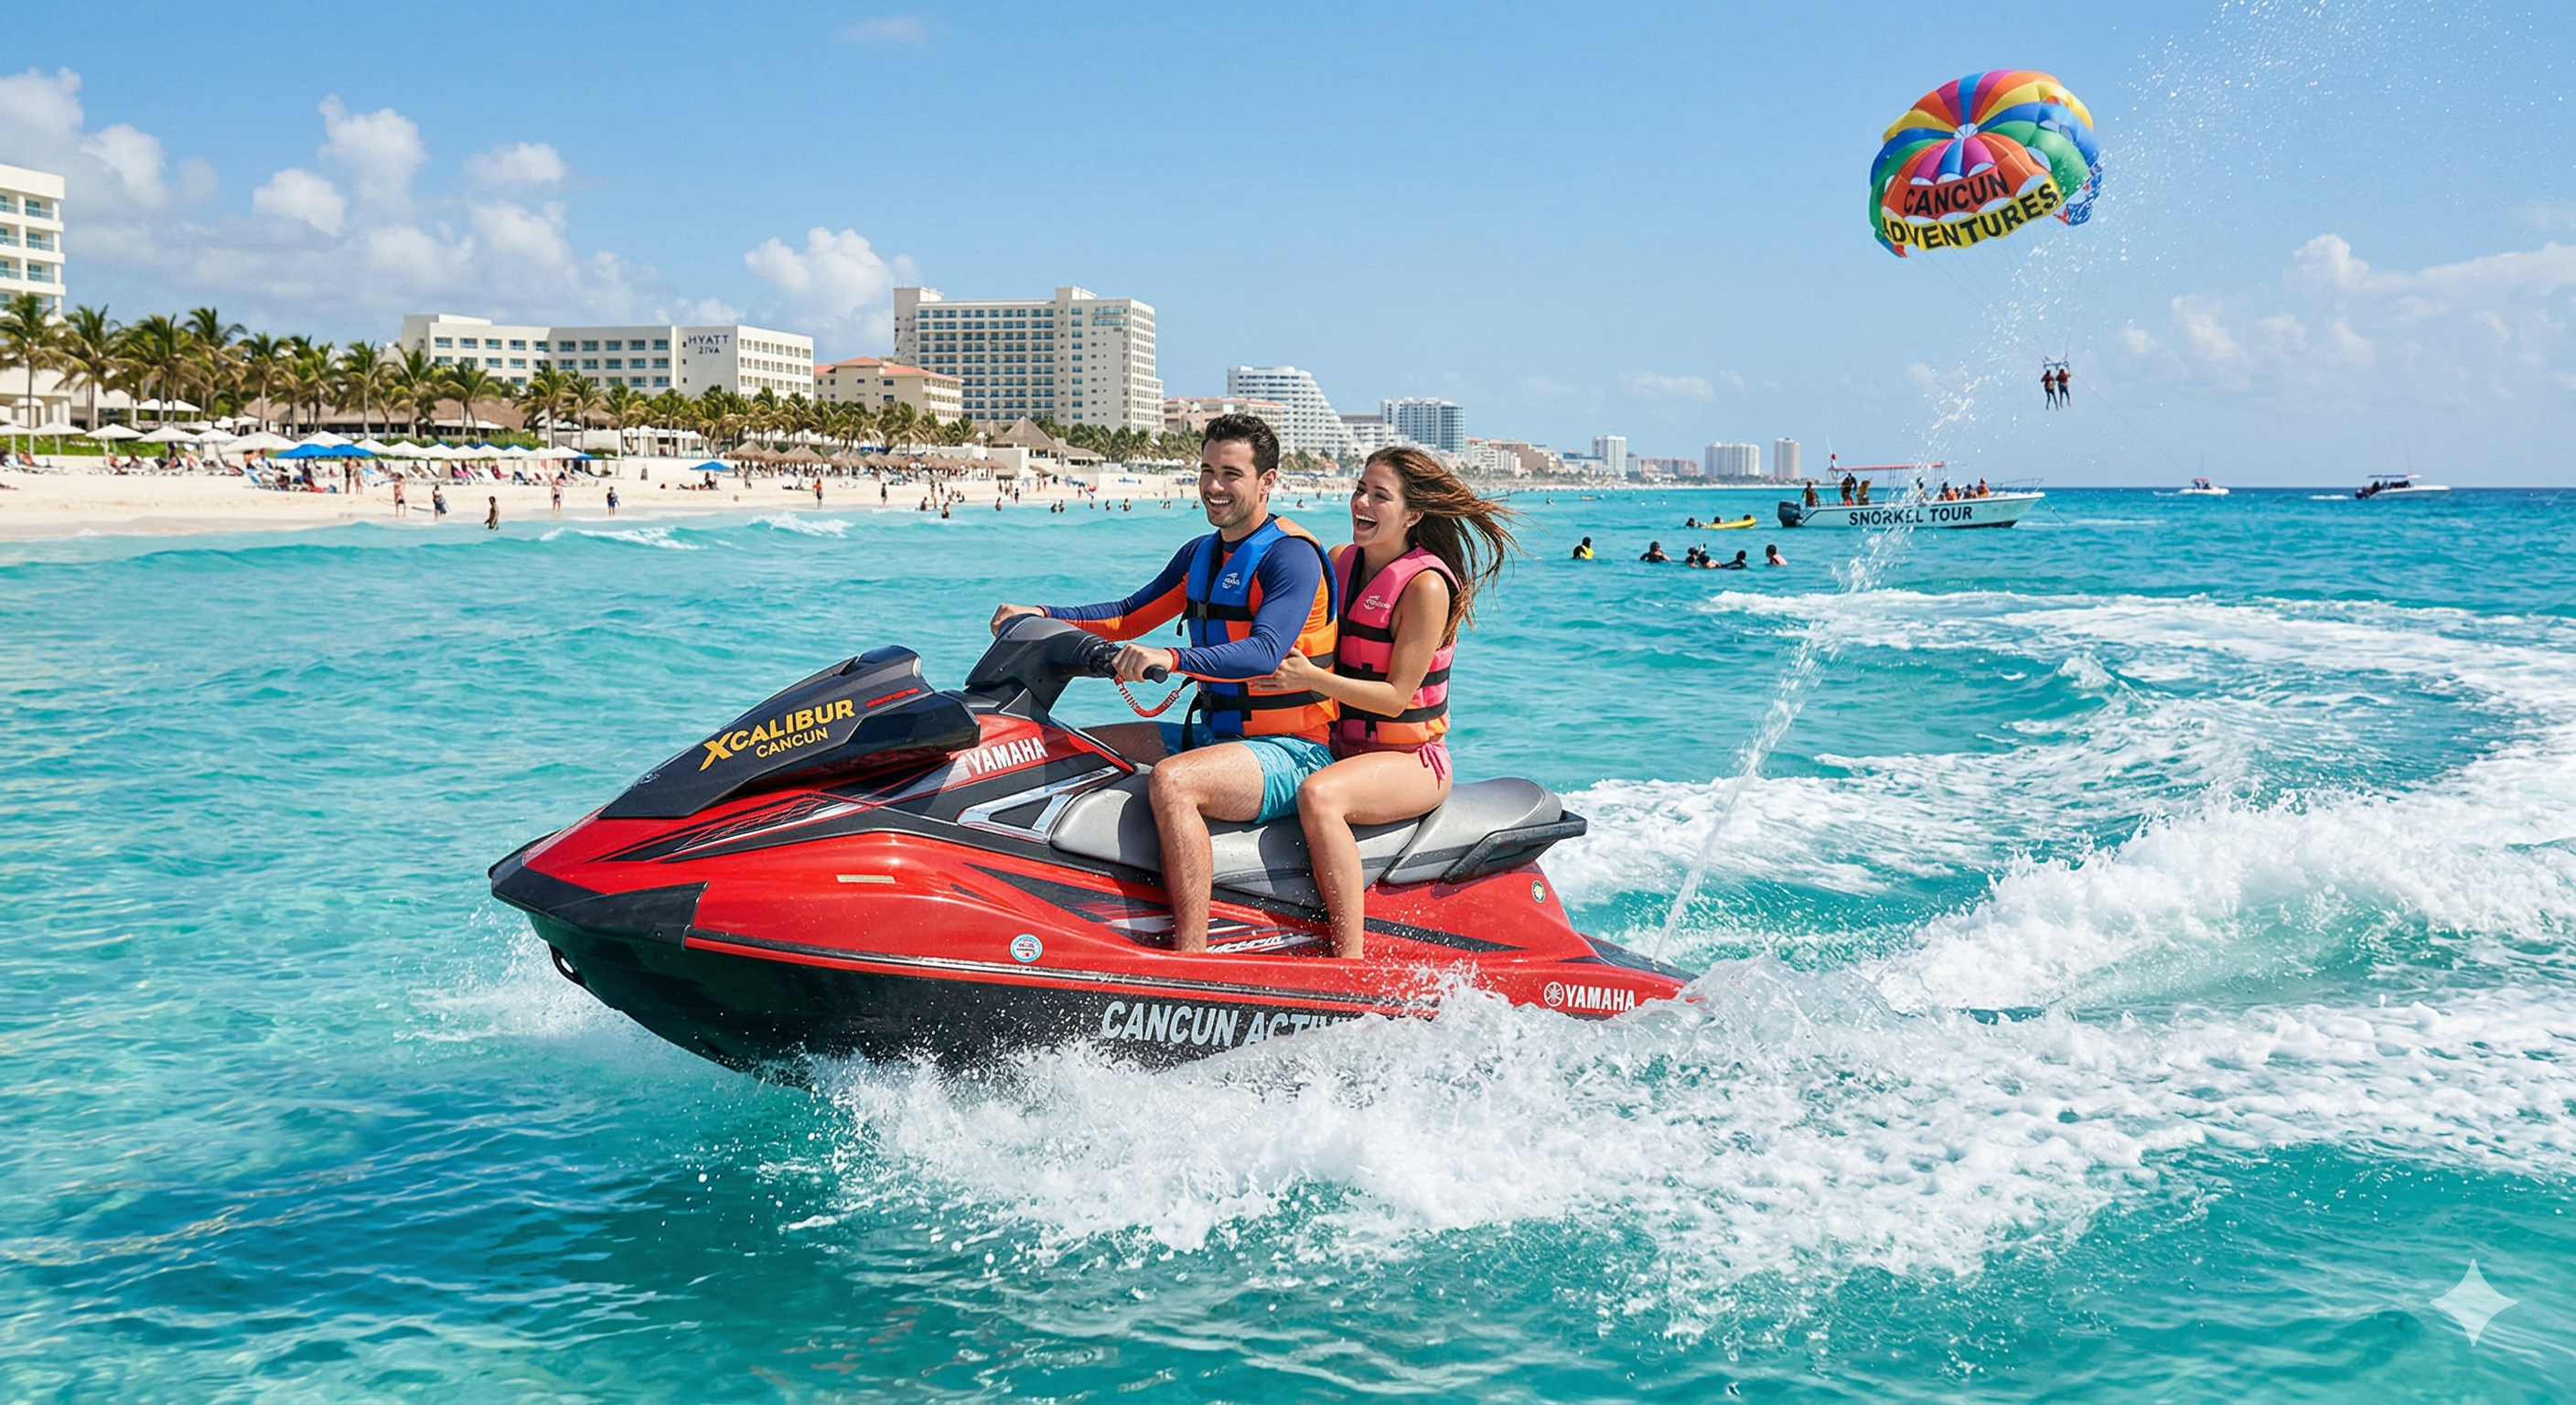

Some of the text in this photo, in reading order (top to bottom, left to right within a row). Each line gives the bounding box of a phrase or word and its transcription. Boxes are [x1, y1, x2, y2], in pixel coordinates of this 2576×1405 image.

[1904, 170, 2010, 216] CANCUN
[688, 335, 729, 345] HYATT
[1849, 506, 1972, 526] SNORKEL TOUR
[699, 699, 856, 772] XCALIBUR
[756, 727, 829, 758] CANCUN
[965, 736, 1048, 775] YAMAHA
[1565, 983, 1635, 1012] YAMAHA
[1101, 1001, 1240, 1046] CANCUN
